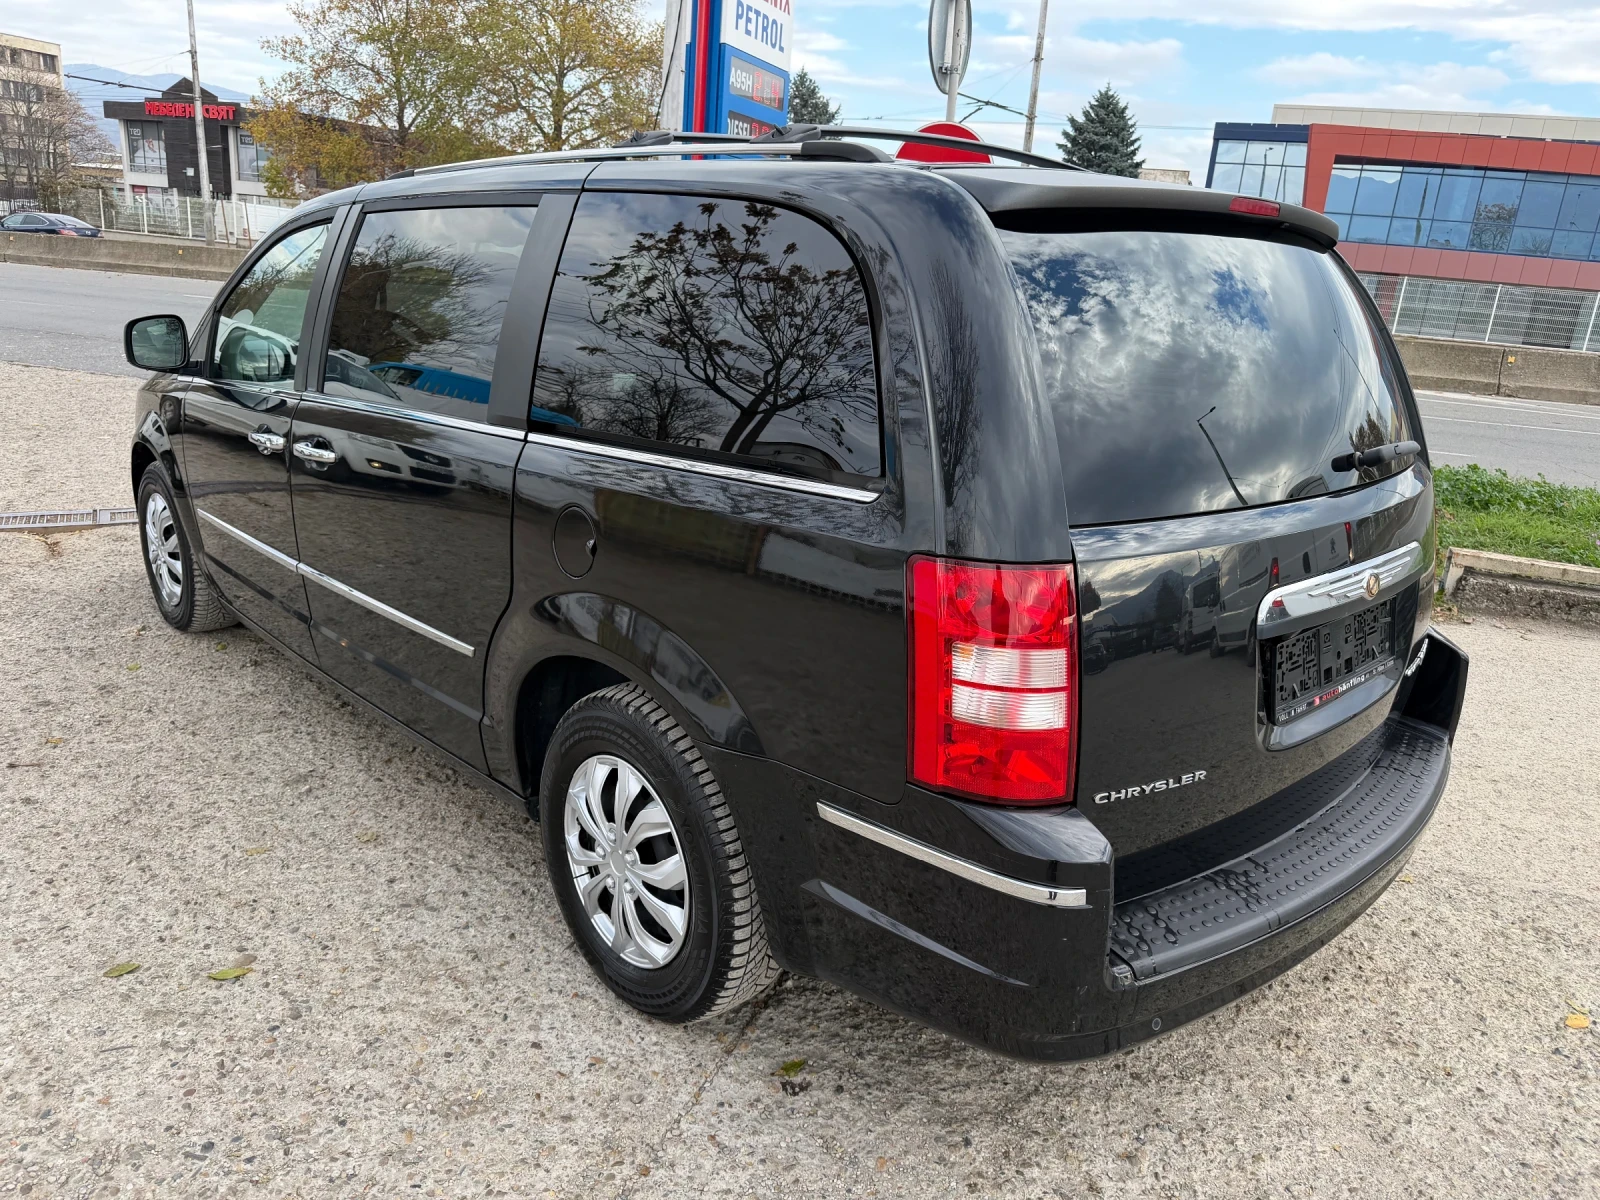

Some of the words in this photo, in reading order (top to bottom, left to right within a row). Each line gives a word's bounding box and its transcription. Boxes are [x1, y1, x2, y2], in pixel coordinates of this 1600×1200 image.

[735, 0, 785, 53] PETROL
[729, 67, 752, 93] A95H
[202, 104, 236, 120] СВЯТ
[1093, 770, 1207, 804] CHRYSLER
